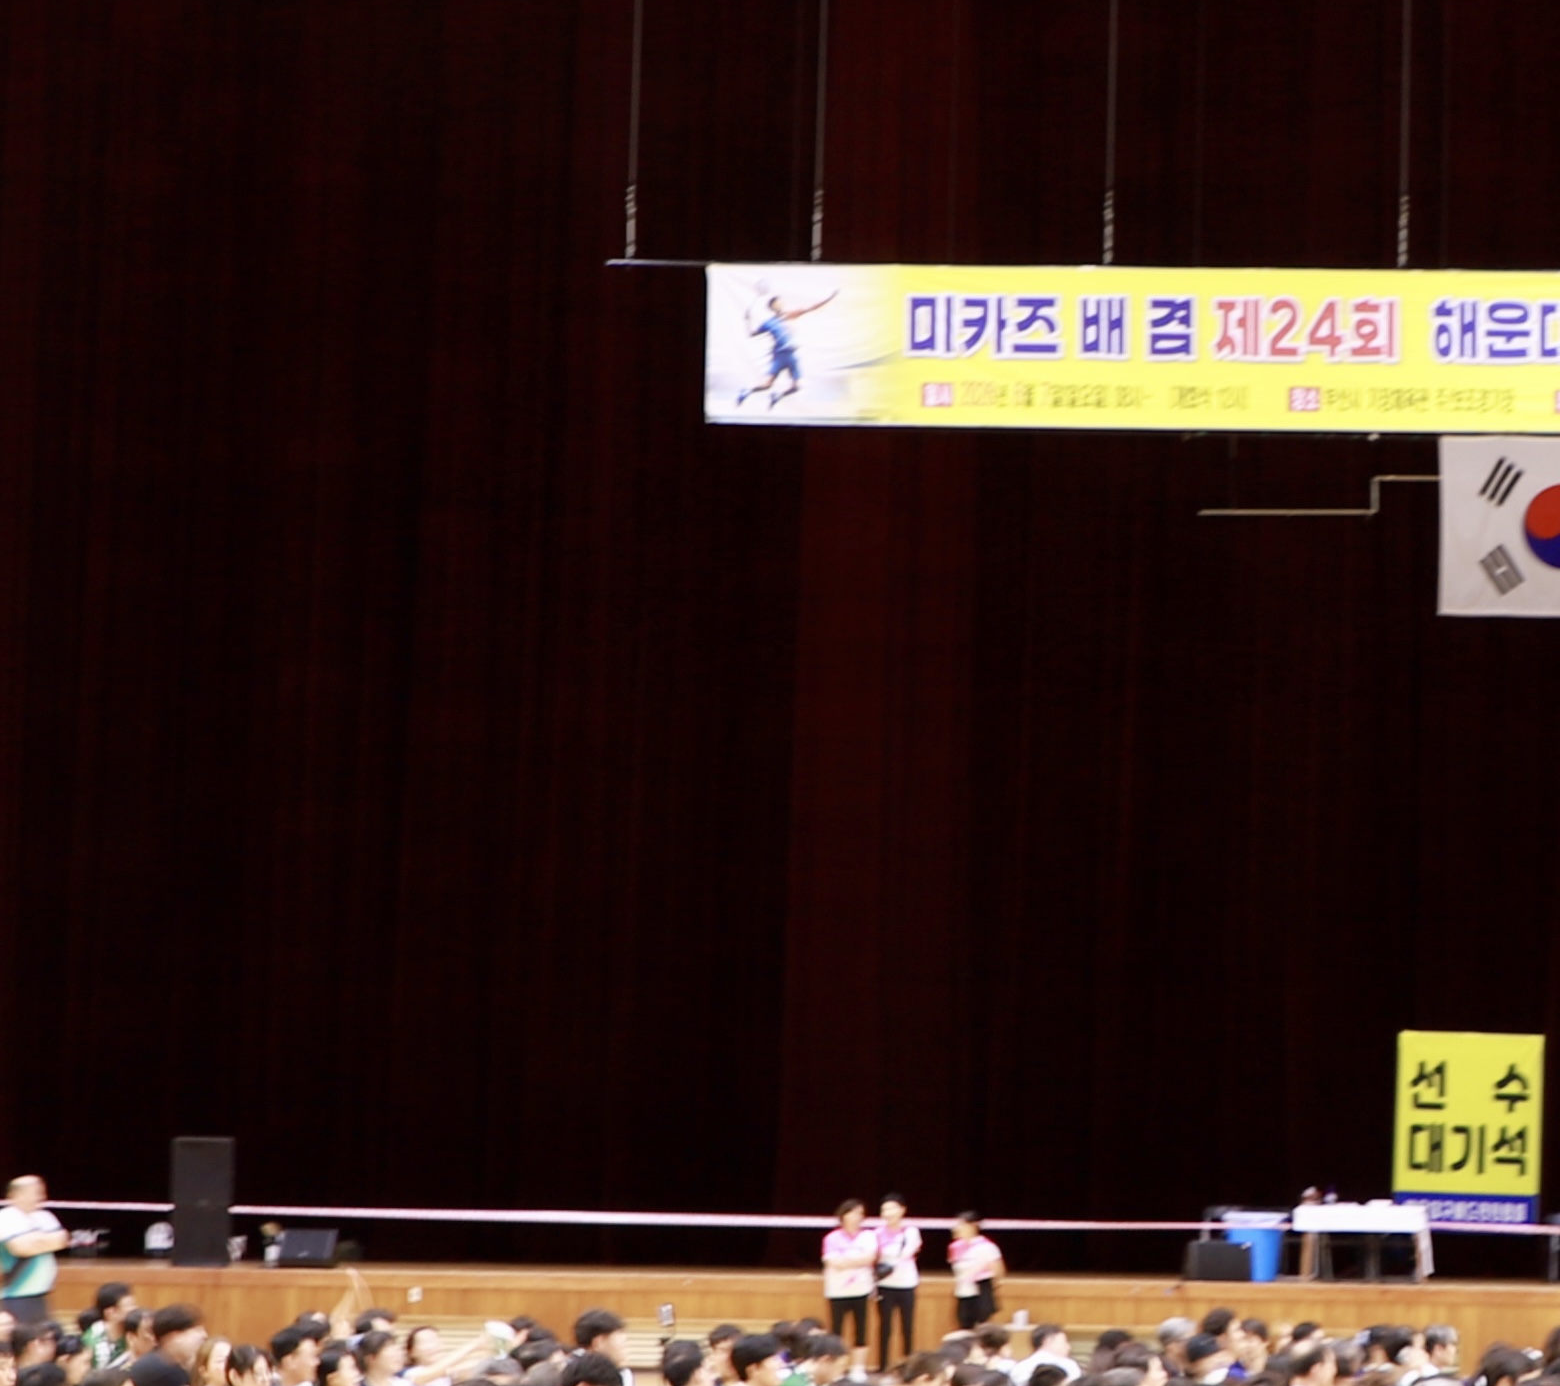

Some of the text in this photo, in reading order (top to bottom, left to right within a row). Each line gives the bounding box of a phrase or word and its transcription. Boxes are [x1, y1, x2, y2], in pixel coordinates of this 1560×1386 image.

[906, 293, 1064, 359] 미카즈
[1080, 294, 1128, 360] 배
[1146, 295, 1197, 361] 겸
[1214, 296, 1400, 362] 제24회
[1409, 1060, 1530, 1114] 선 수
[1408, 1123, 1528, 1177] 대기석
